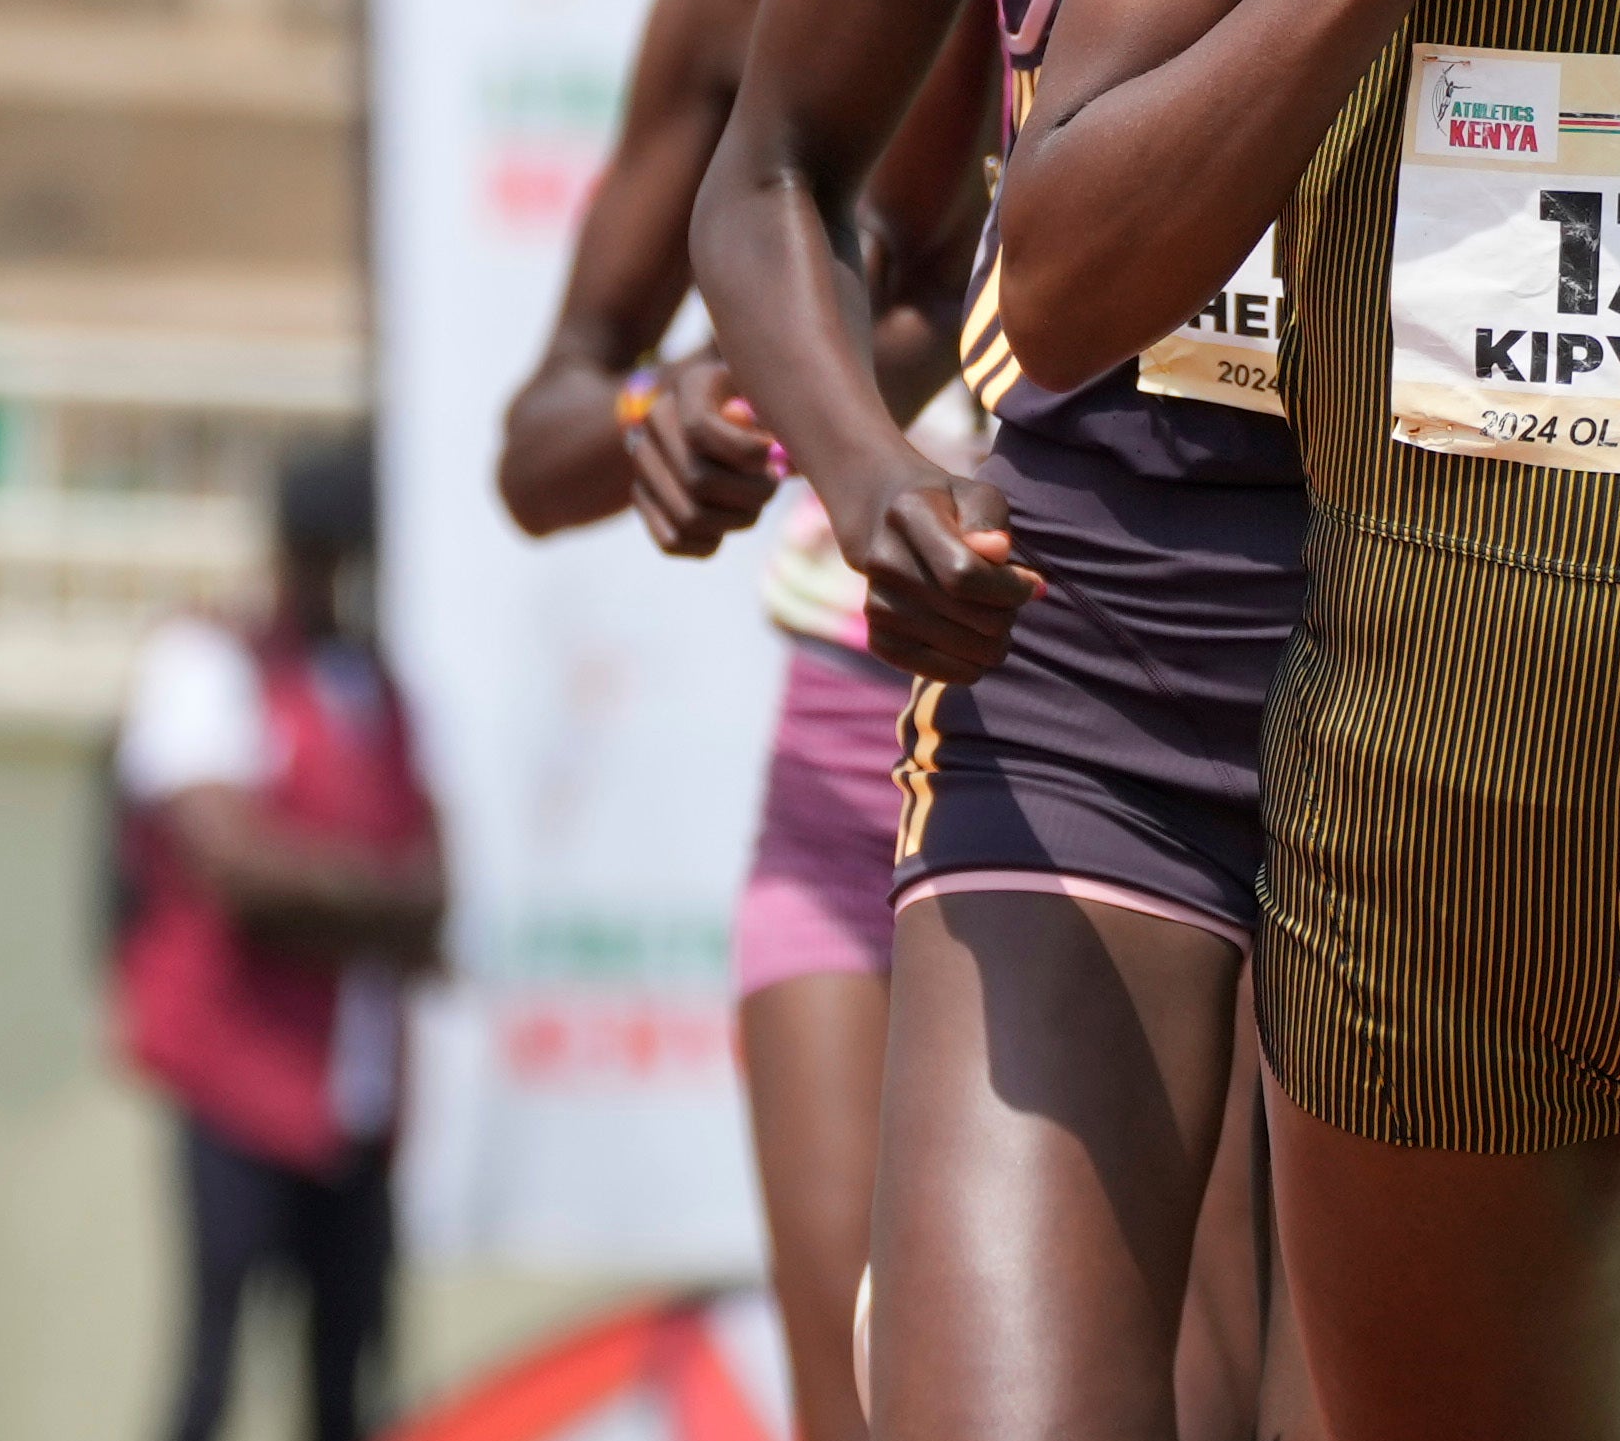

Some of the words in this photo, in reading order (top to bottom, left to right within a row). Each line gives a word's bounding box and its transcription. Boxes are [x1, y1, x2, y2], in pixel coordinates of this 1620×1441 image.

[1451, 101, 1535, 122] ATHLETICS
[1449, 119, 1539, 152] KENYA
[1480, 410, 1559, 444] 2024
